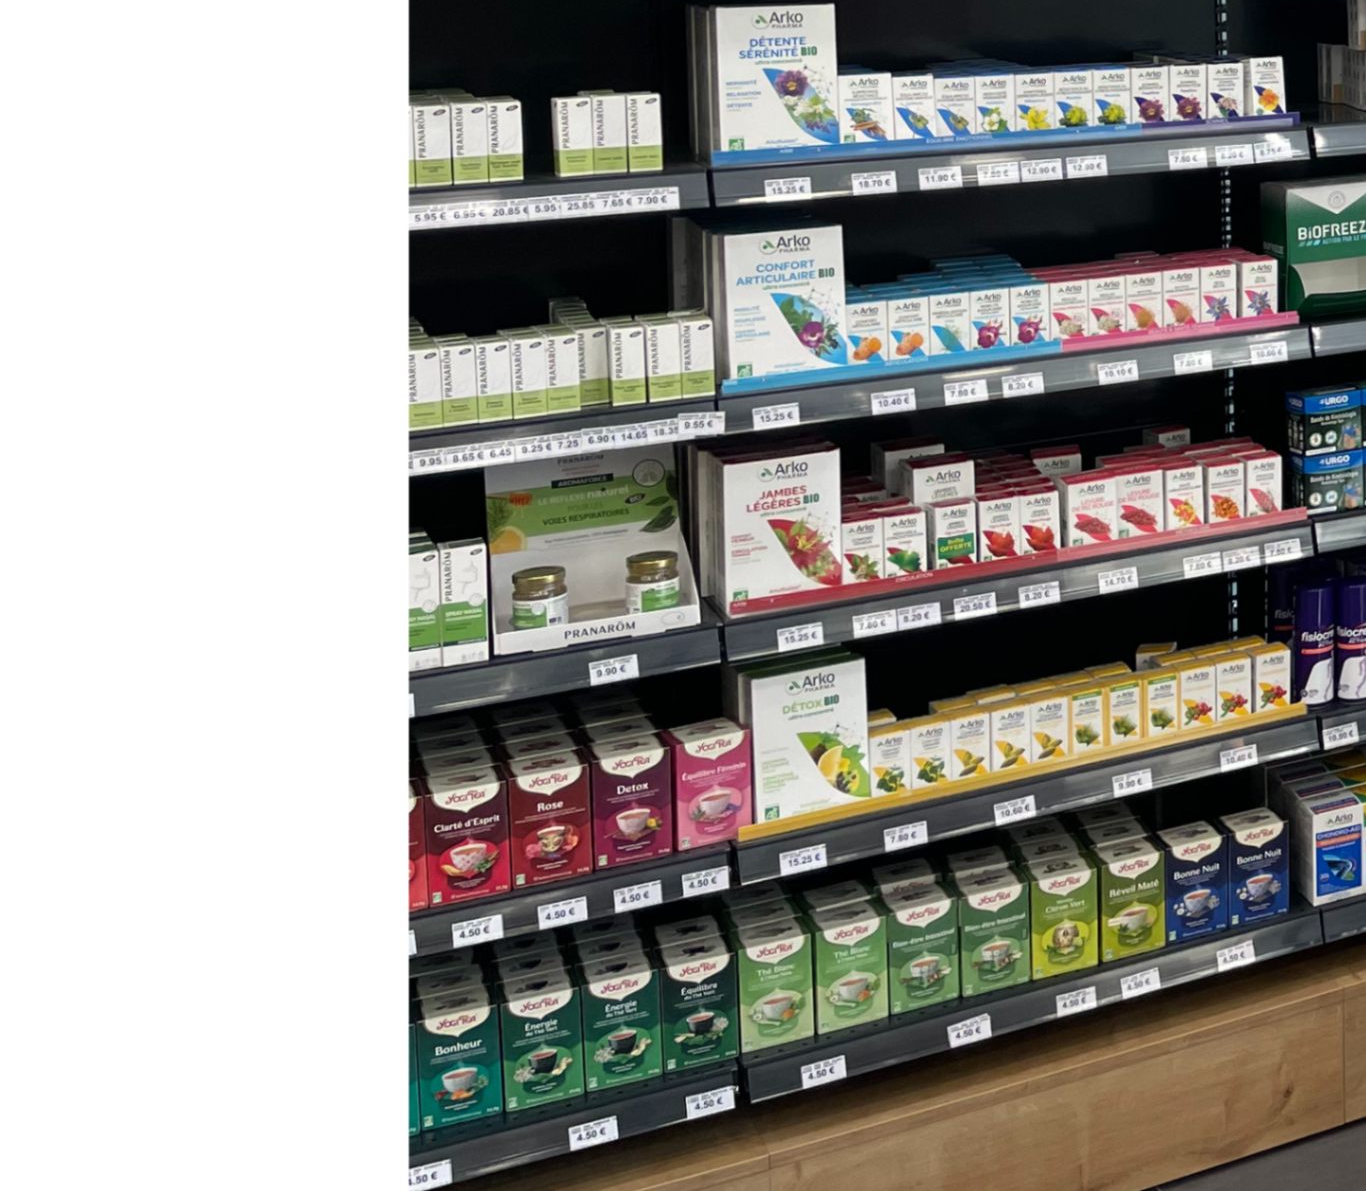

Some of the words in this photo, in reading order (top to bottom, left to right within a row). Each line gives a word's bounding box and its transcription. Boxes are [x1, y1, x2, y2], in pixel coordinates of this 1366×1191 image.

[770, 11, 803, 24] Arko
[750, 36, 806, 47] DÉTENTE
[739, 47, 799, 59] SÉRÉNITÉ
[801, 46, 817, 56] BIO
[777, 236, 810, 248] Arko
[756, 260, 814, 272] CONFORT
[736, 270, 816, 286] ARTICULAIRE
[818, 268, 834, 278] BIO
[760, 413, 785, 423] 15.25
[774, 461, 808, 476] Arko
[759, 485, 807, 500] JAMBES
[746, 497, 800, 513] LÉGÈRES
[803, 493, 819, 505] BIO
[564, 621, 636, 639] PRANARÔM
[802, 673, 835, 688] Arko
[782, 697, 822, 715] DÉTOX
[824, 695, 839, 706] BIO
[617, 781, 648, 795] Detox
[537, 799, 563, 812] Rose
[434, 821, 462, 834] Clarté
[1173, 869, 1201, 880] Bonne
[1202, 863, 1220, 873] Nuit
[1109, 883, 1136, 898] Réveil
[1138, 879, 1159, 889] Maté
[621, 892, 642, 903] 4.50
[546, 909, 567, 920] 4.50
[681, 981, 717, 997] Équilibre
[525, 1019, 558, 1032] Énergie
[435, 1039, 482, 1057] Bonheur
